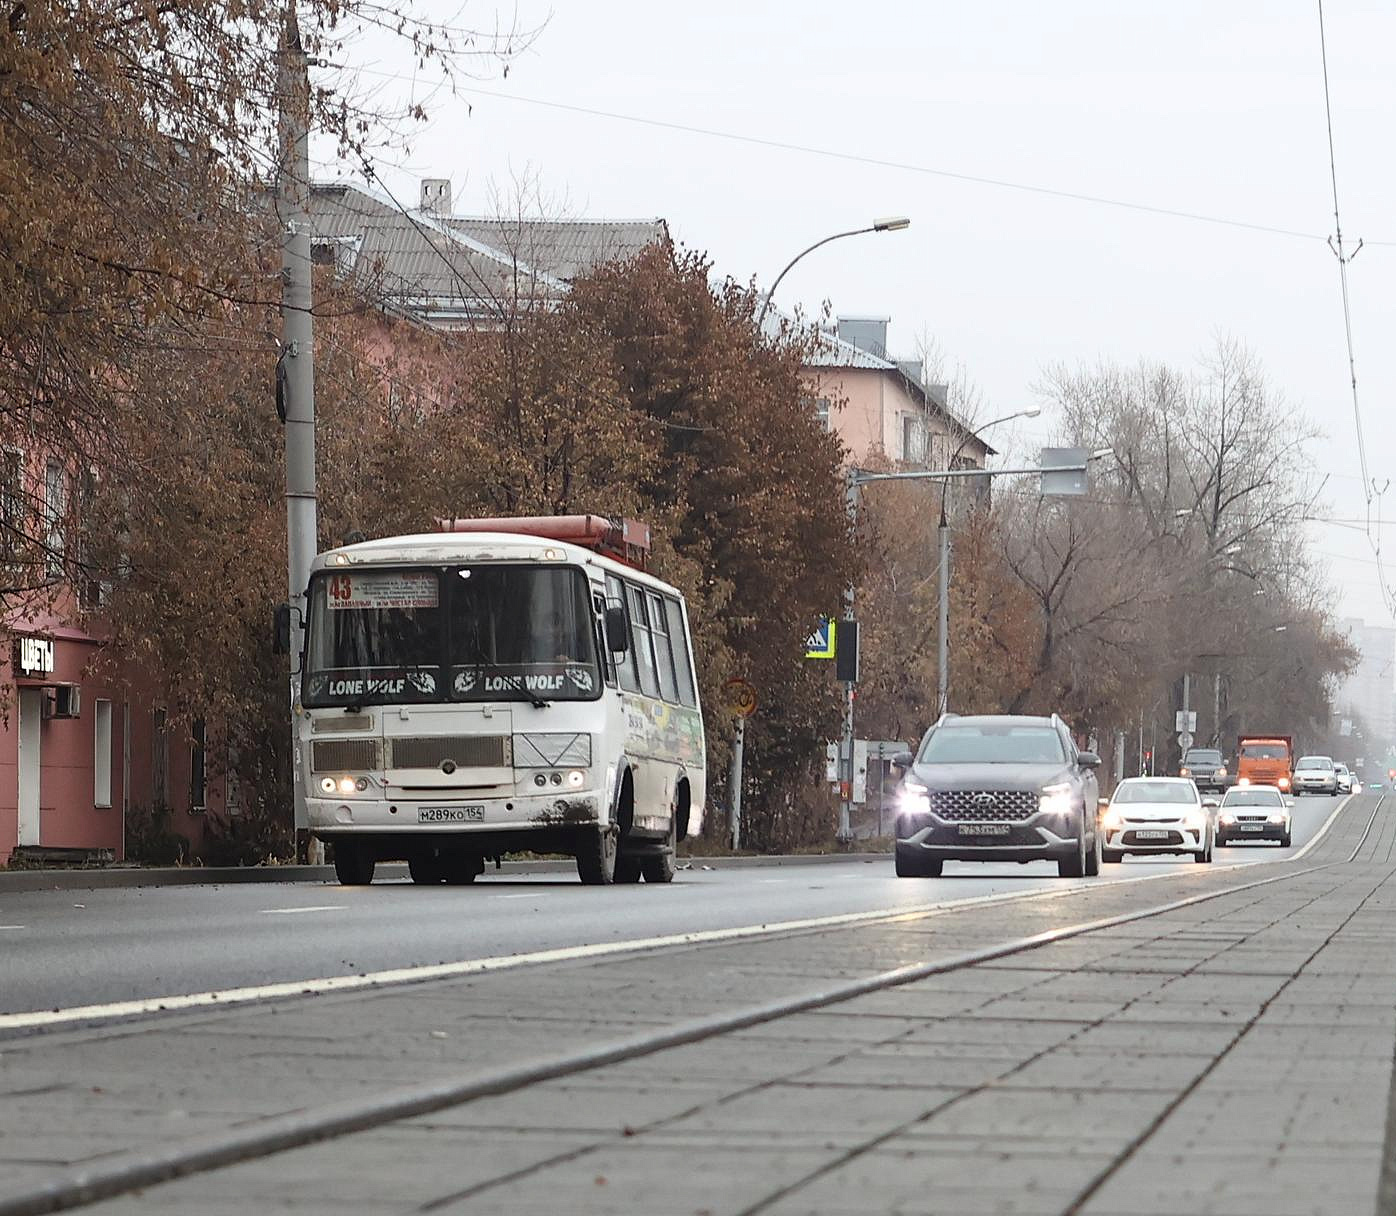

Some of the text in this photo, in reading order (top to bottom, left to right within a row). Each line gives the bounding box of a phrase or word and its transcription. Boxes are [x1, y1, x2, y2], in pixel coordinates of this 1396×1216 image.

[329, 575, 352, 600] 43
[21, 637, 54, 675] ЦВЕТЫ
[329, 680, 405, 695] LONE WOLF
[485, 675, 564, 691] LONE WOLF
